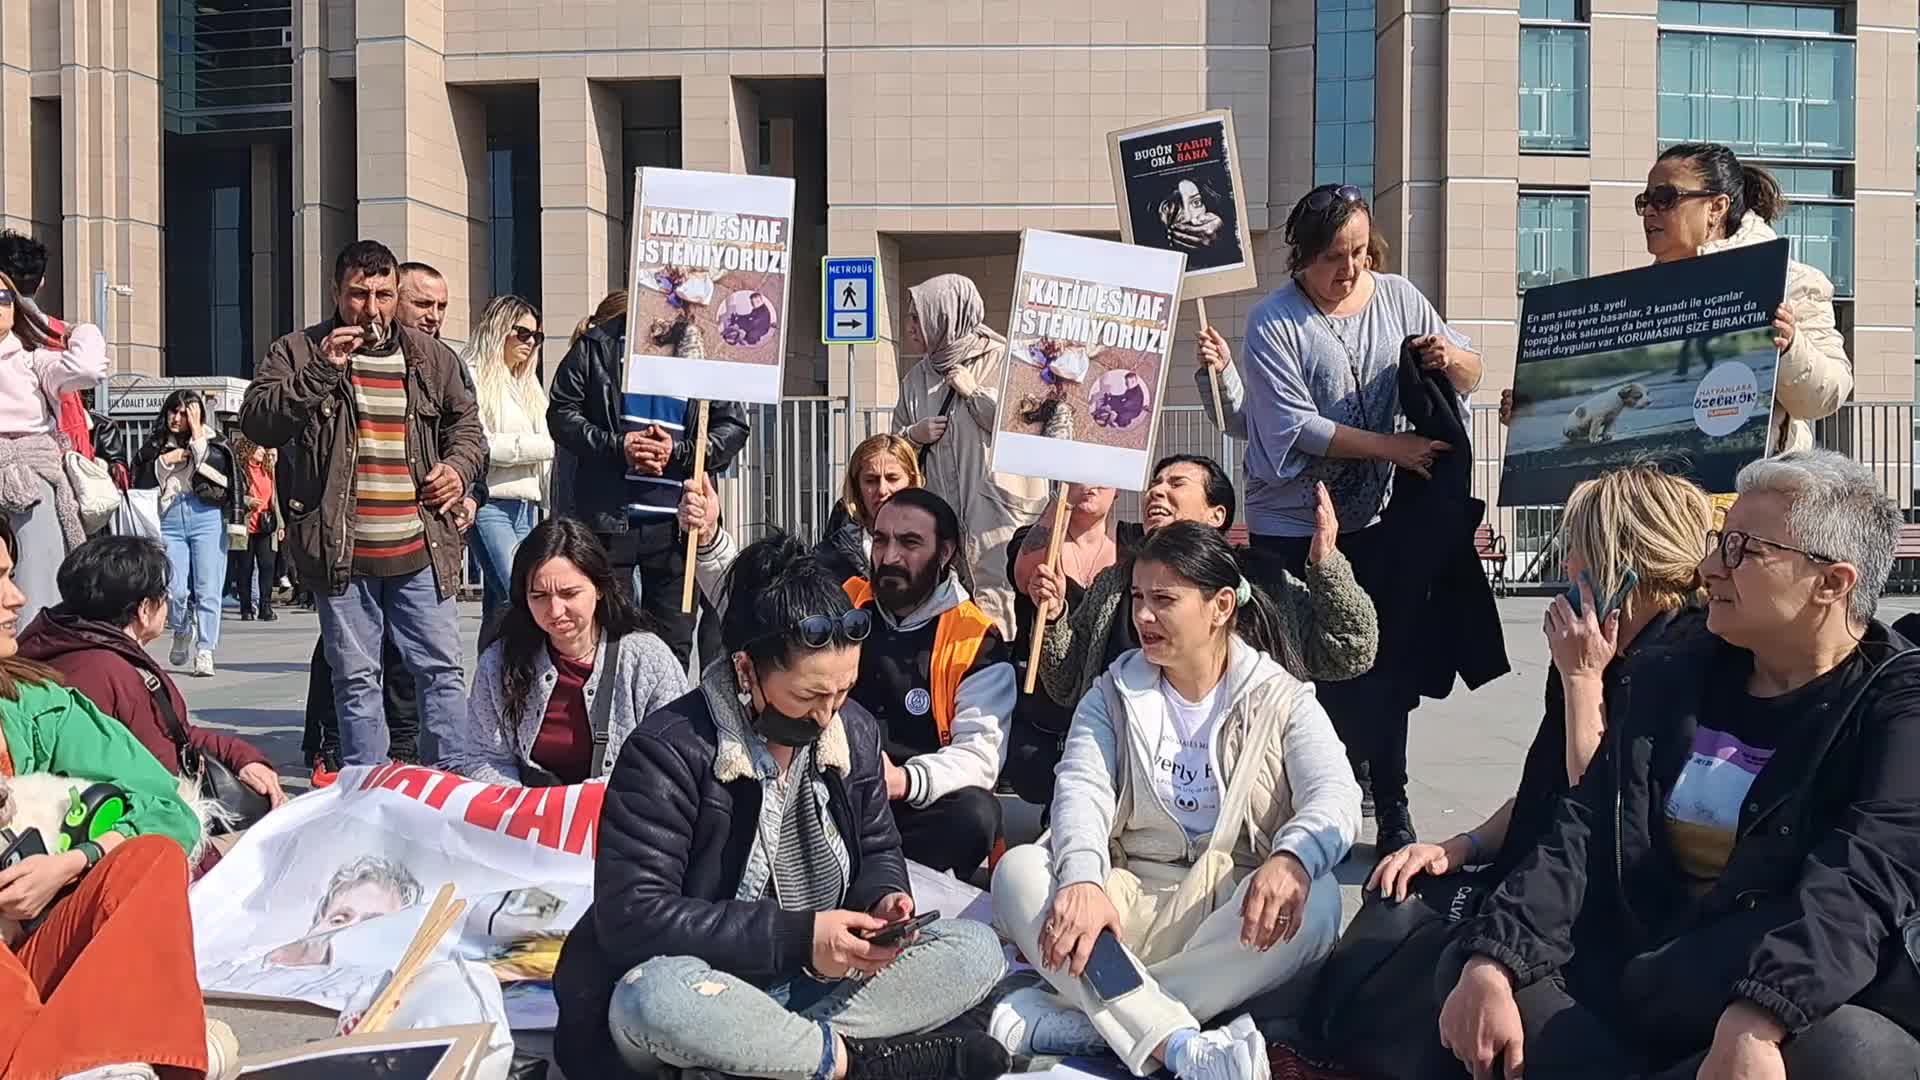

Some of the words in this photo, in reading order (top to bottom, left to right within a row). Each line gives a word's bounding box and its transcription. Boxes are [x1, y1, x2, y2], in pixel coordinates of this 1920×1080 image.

[1134, 144, 1173, 160] BUGÜN
[1175, 137, 1213, 152] YARIN
[1150, 155, 1175, 168] ONA
[1177, 149, 1208, 162] SANA
[649, 210, 711, 239] KATİL
[716, 216, 783, 244] ESNAF
[829, 263, 873, 274] METROBÜS
[1028, 276, 1091, 312] KATİL
[1095, 286, 1165, 321] ESNAF
[1527, 313, 1540, 323] En
[1541, 312, 1555, 320] am
[1557, 304, 1586, 318] suresi
[1587, 303, 1602, 313] 38.
[1604, 297, 1627, 312] ayeti
[1538, 322, 1563, 335] ayağı
[1564, 320, 1576, 330] ile
[1578, 318, 1598, 329] yere
[1600, 308, 1643, 324] basanlar,
[1646, 306, 1652, 316] 2
[1654, 300, 1687, 314] kanadı
[1690, 297, 1702, 308] ile
[1704, 290, 1744, 305] uçanlar
[1523, 345, 1551, 359] hisleri
[1552, 341, 1596, 357] duyguları
[1598, 338, 1615, 348] var.
[1617, 325, 1683, 345] KORUMASINI
[1686, 321, 1710, 334] SİZE
[1712, 311, 1769, 330] BIRAKTIM.
[1524, 333, 1559, 347] toprağa
[1561, 330, 1578, 341] kök
[1580, 324, 1619, 339] salanları
[1621, 321, 1634, 332] da
[1636, 318, 1654, 330] ben
[1656, 312, 1700, 328] yarattım.
[1703, 304, 1741, 319] Onların
[1743, 301, 1757, 311] da
[121, 398, 145, 408] ADALET
